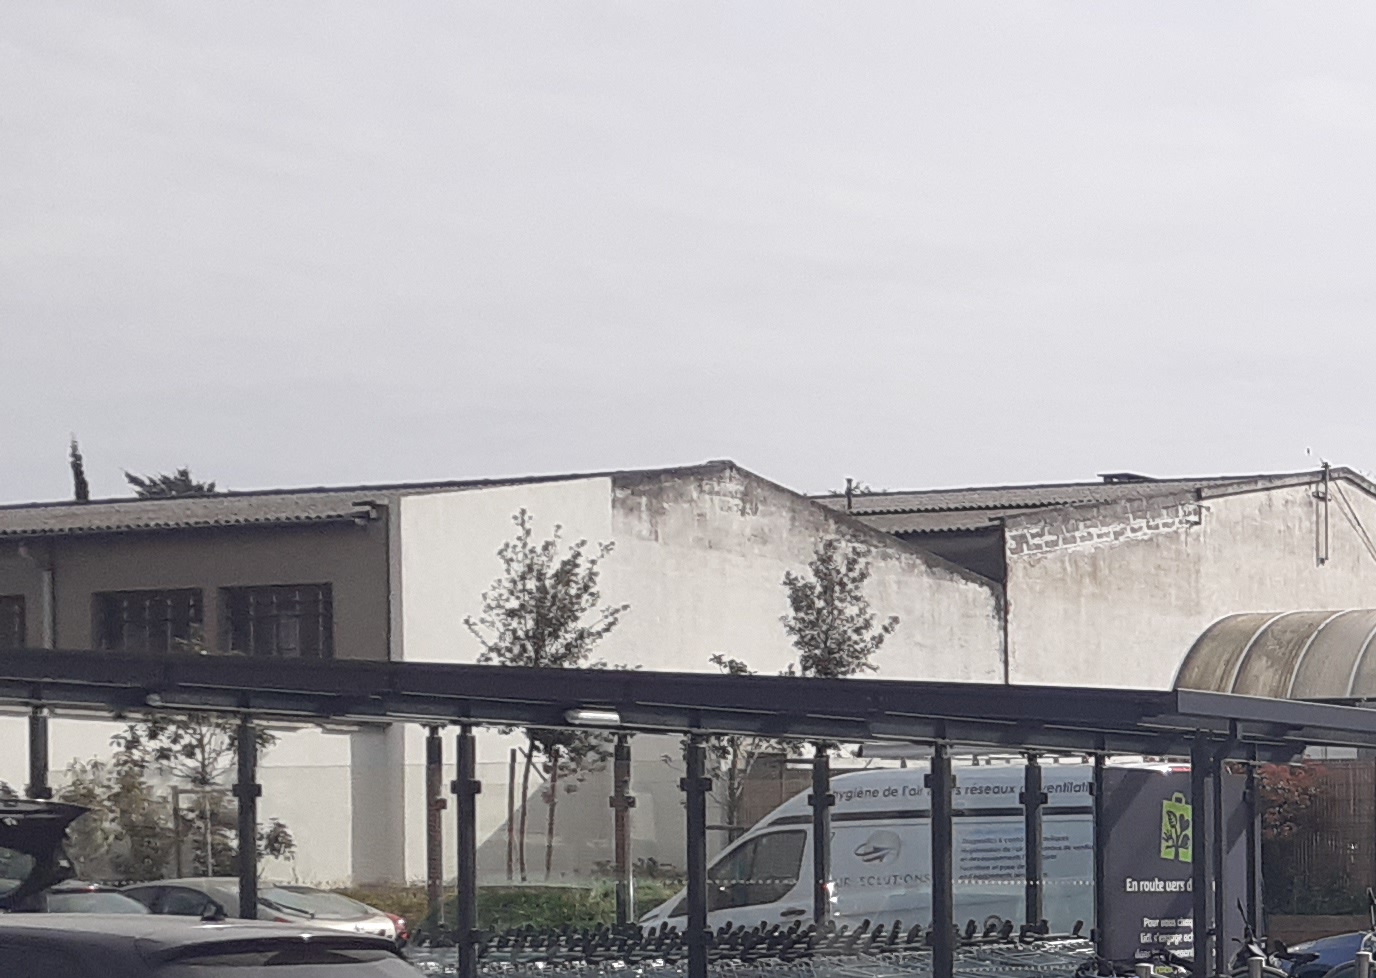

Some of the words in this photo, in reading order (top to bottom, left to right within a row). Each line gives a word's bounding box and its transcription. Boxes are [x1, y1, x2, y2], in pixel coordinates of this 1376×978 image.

[882, 786, 898, 798] de
[964, 781, 1016, 796] réseaux
[1125, 878, 1138, 892] En
[1140, 878, 1164, 892] route
[1166, 879, 1185, 892] vers
